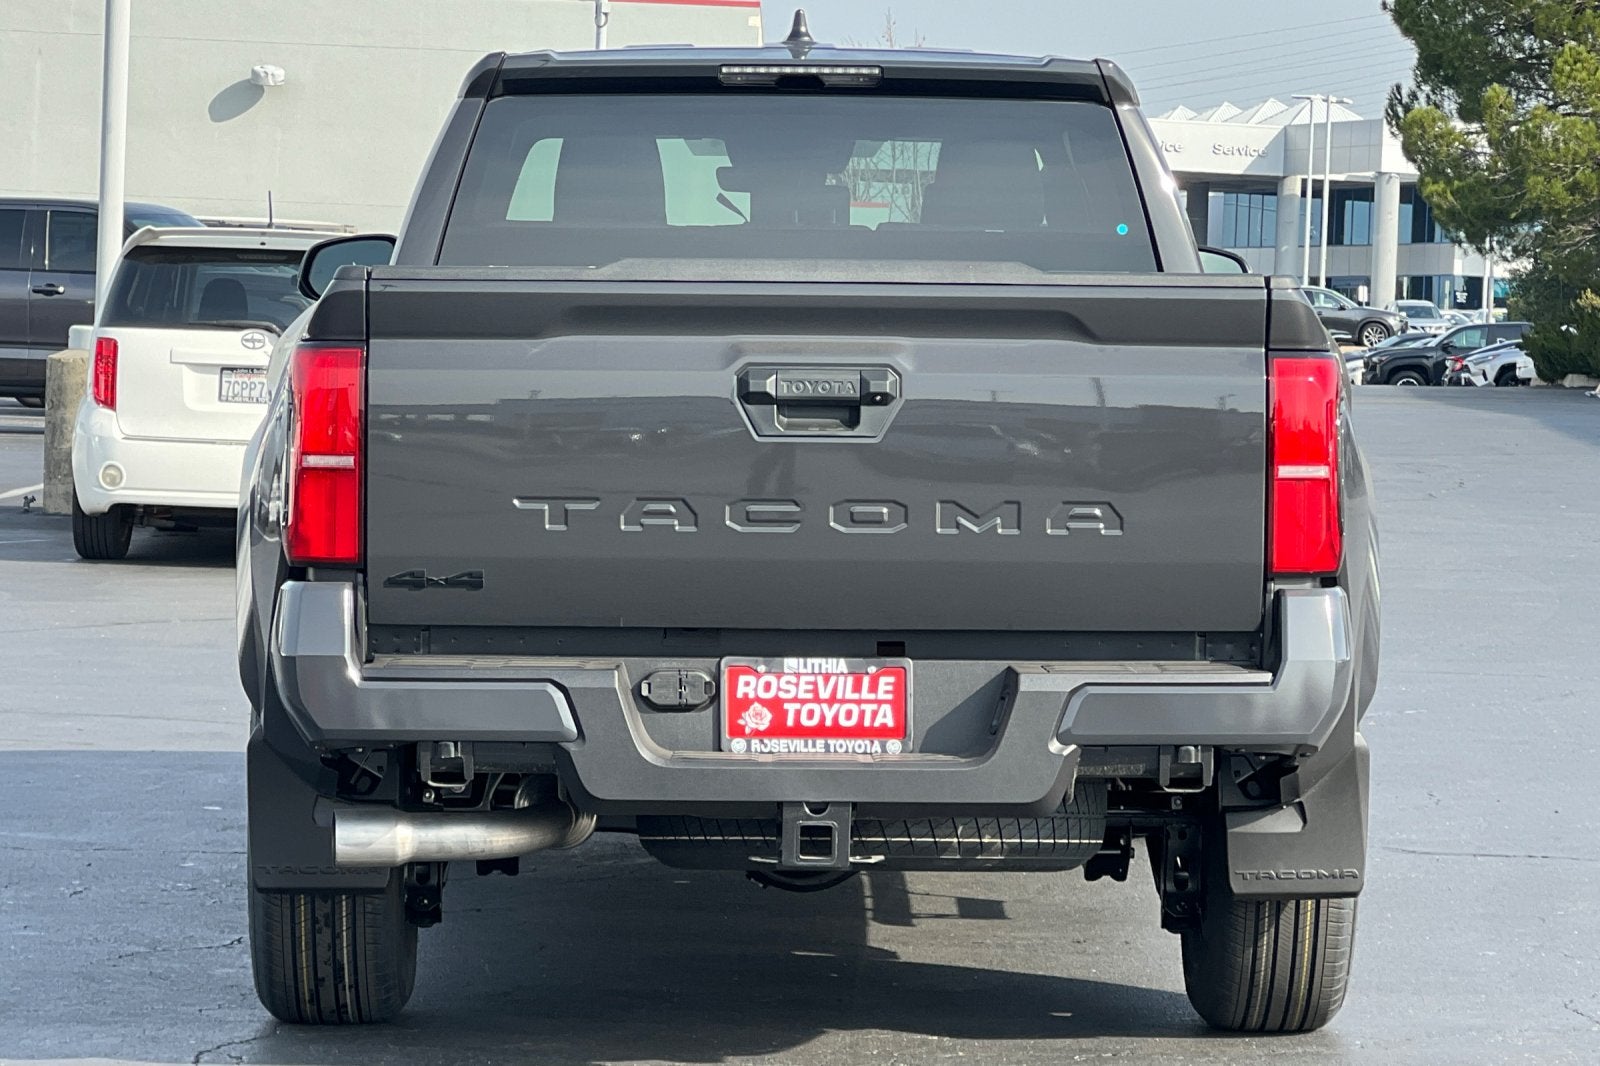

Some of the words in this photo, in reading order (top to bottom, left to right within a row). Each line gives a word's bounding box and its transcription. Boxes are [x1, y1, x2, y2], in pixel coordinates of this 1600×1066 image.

[1212, 142, 1267, 157] Service
[781, 380, 857, 394] TOYOTA
[512, 495, 1124, 536] TACOMA
[798, 658, 848, 674] LITHIA
[736, 674, 896, 700] ROSEVILLE
[783, 702, 895, 728] TOYOTA
[751, 739, 827, 753] ROSEVILLE
[829, 739, 882, 754] TOYOTA
[1234, 868, 1360, 881] TACOMA
